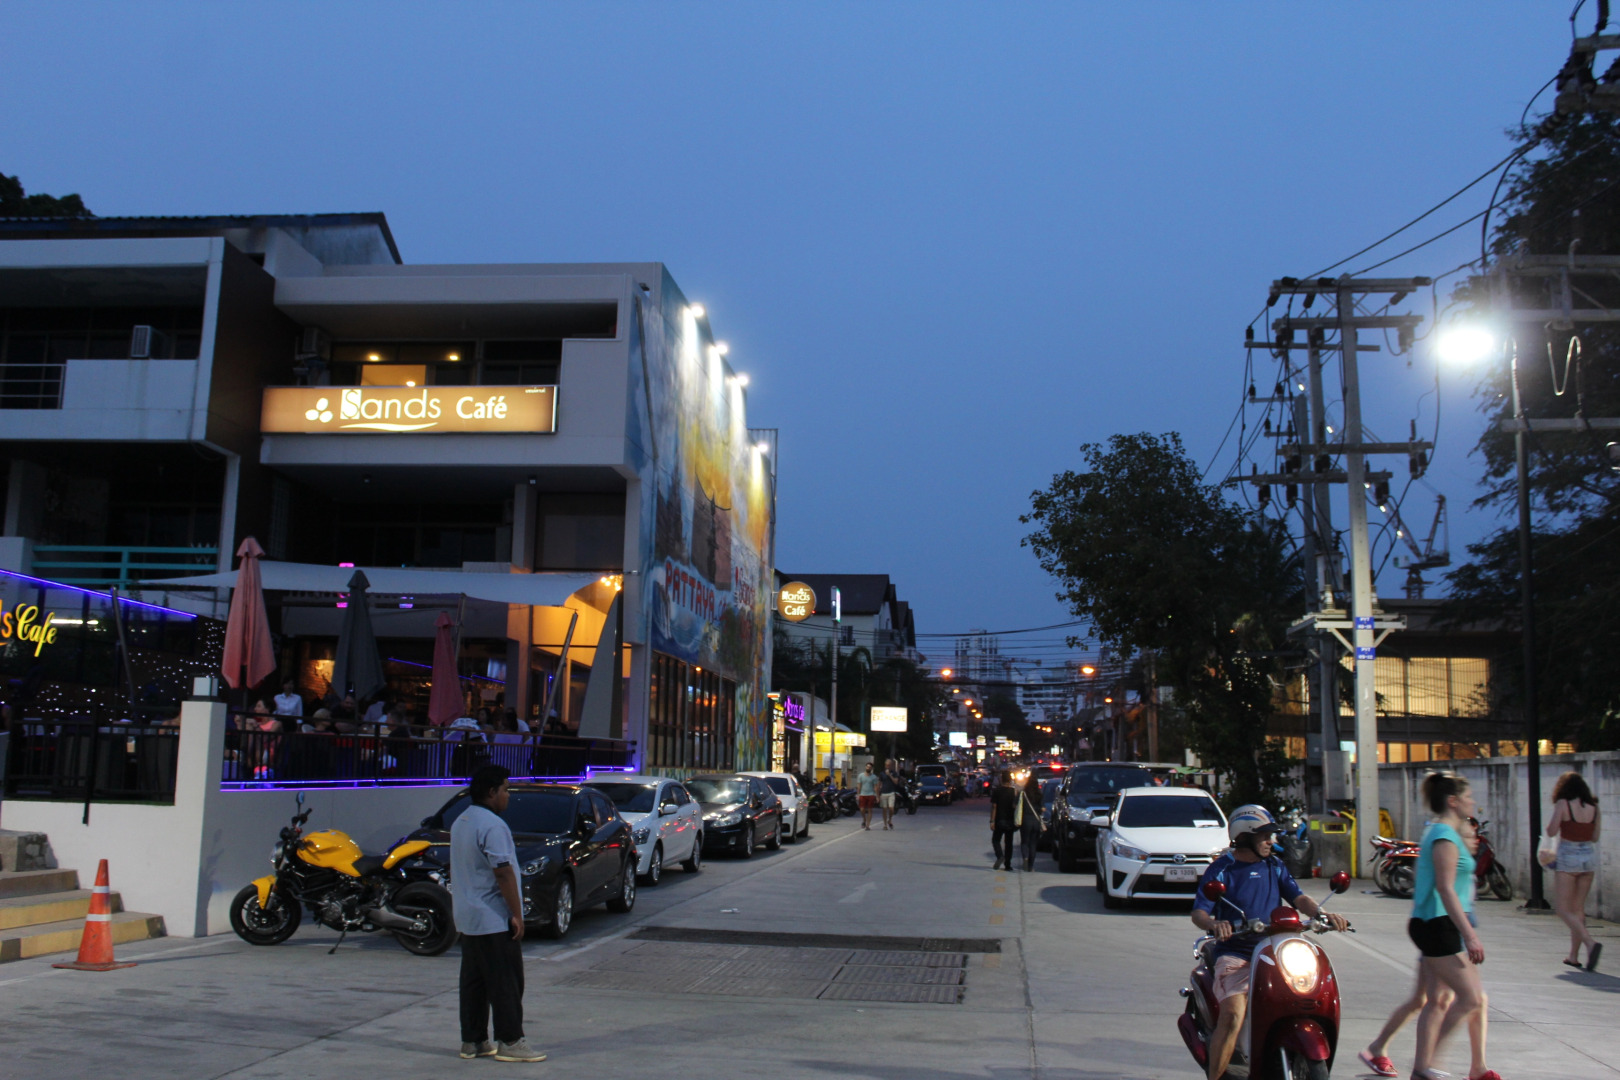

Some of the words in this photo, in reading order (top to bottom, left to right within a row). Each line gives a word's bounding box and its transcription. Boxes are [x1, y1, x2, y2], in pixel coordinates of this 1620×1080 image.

[340, 388, 442, 420] Sands
[455, 395, 508, 420] Café
[665, 561, 715, 624] PATTAYA
[781, 590, 811, 601] Sands
[784, 605, 806, 616] Café
[15, 603, 57, 657] Cafe
[816, 736, 856, 745] EXCANGE
